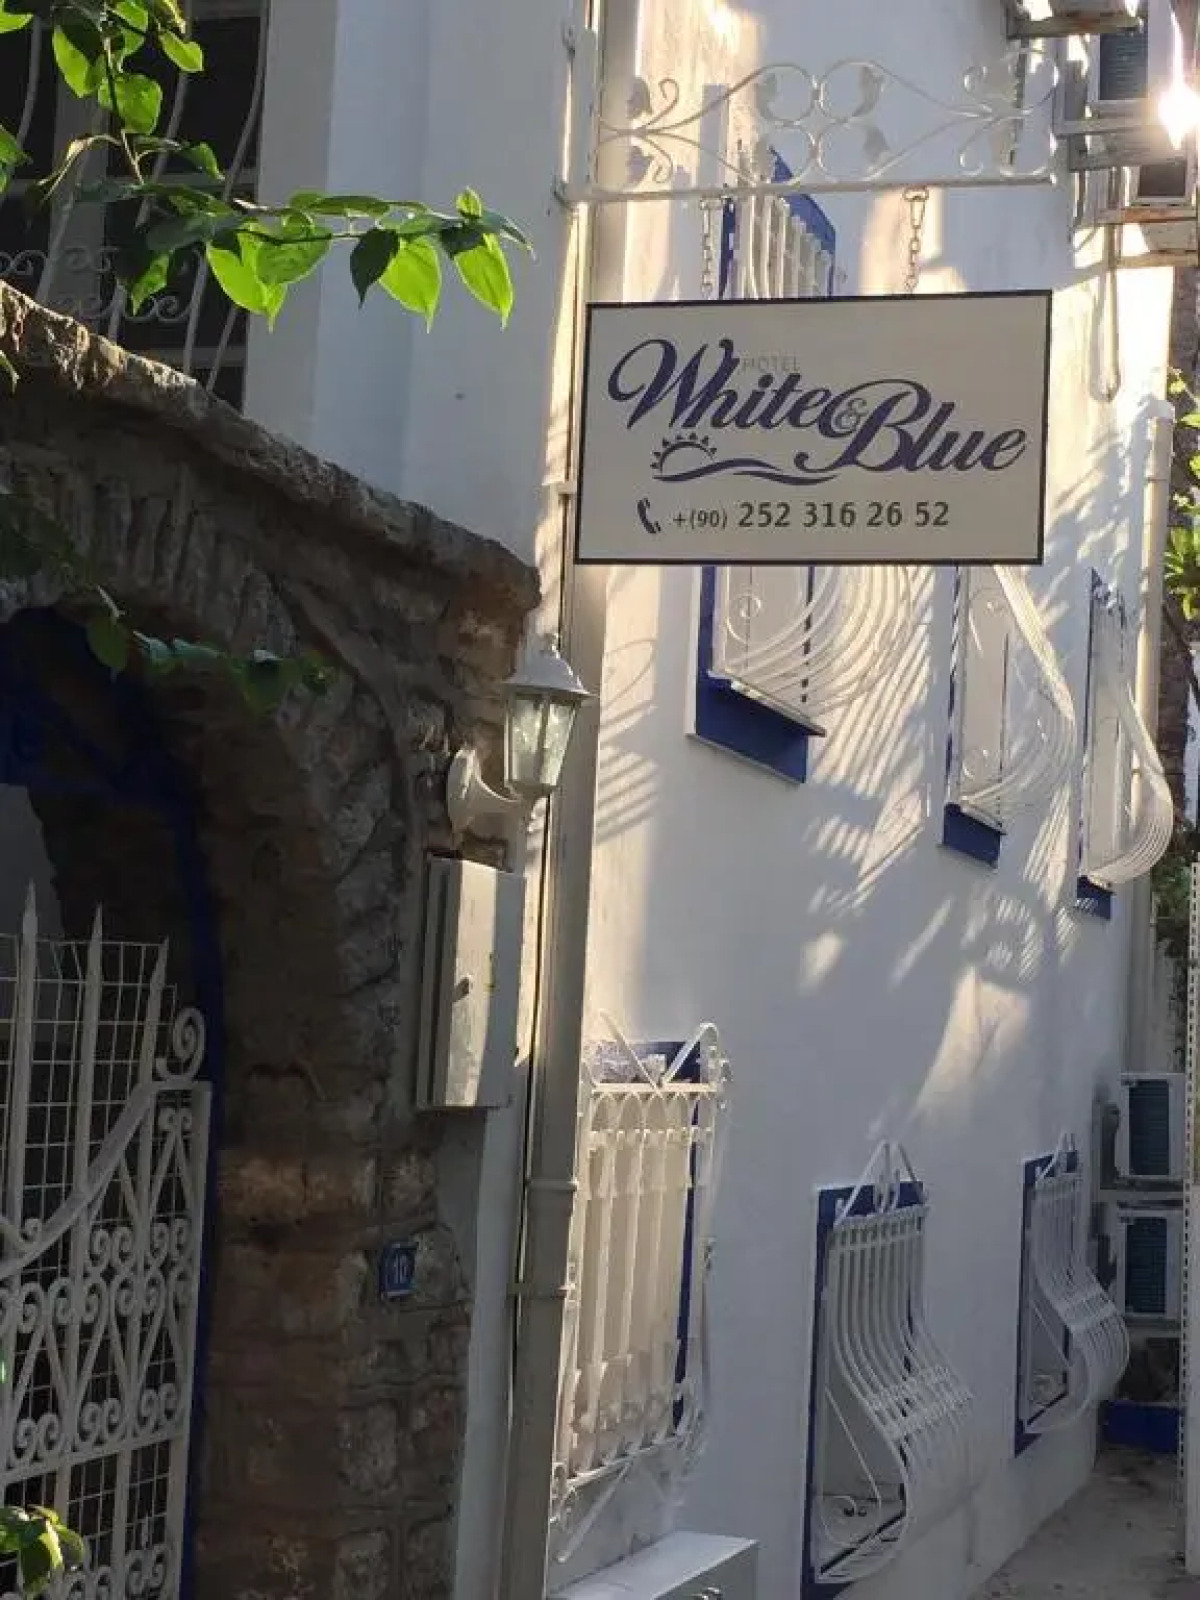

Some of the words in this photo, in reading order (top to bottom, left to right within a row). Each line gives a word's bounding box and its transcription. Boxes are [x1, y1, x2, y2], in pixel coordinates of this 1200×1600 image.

[742, 355, 801, 372] HOTEL
[607, 338, 832, 430] White
[793, 378, 1027, 473] Blue
[834, 397, 868, 433] &
[672, 508, 729, 530] +(90)
[737, 501, 791, 528] 252
[801, 501, 857, 528] 316
[865, 501, 903, 528] 26
[914, 501, 950, 528] 52
